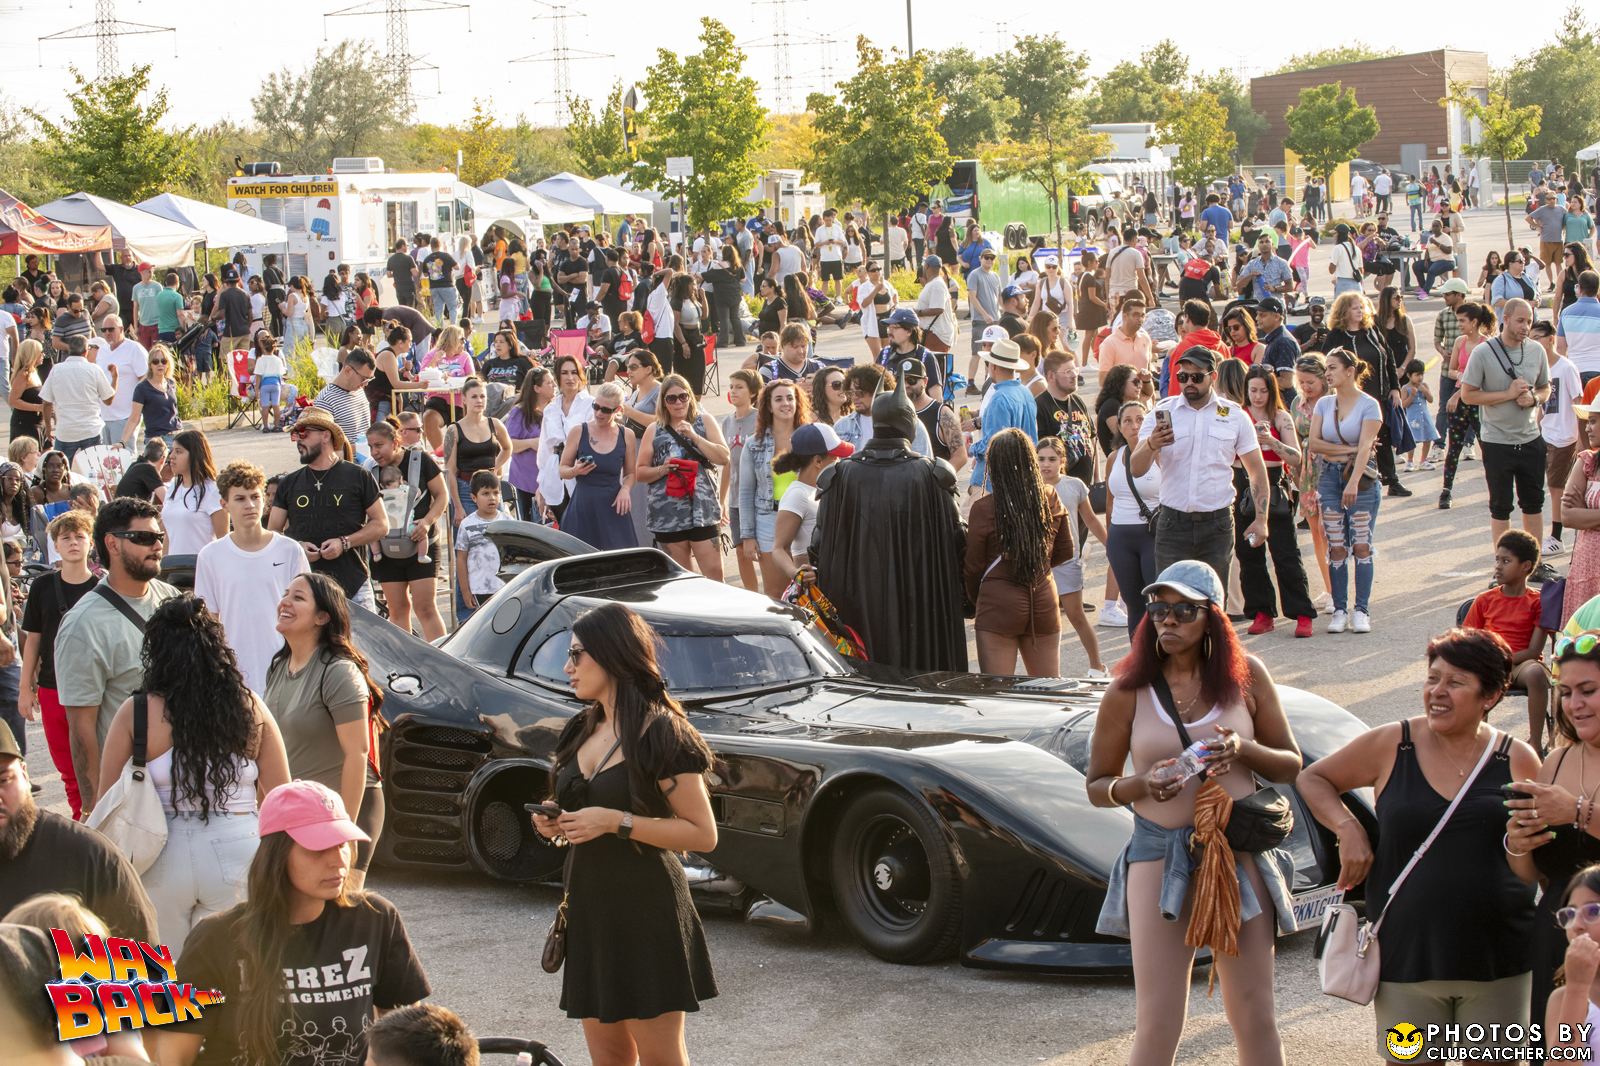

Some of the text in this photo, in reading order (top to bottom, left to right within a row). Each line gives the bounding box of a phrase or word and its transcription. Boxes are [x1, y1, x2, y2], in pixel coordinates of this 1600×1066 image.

[234, 184, 334, 195] WATCH FOR CHILDREN
[279, 984, 372, 1004] AGEMENT
